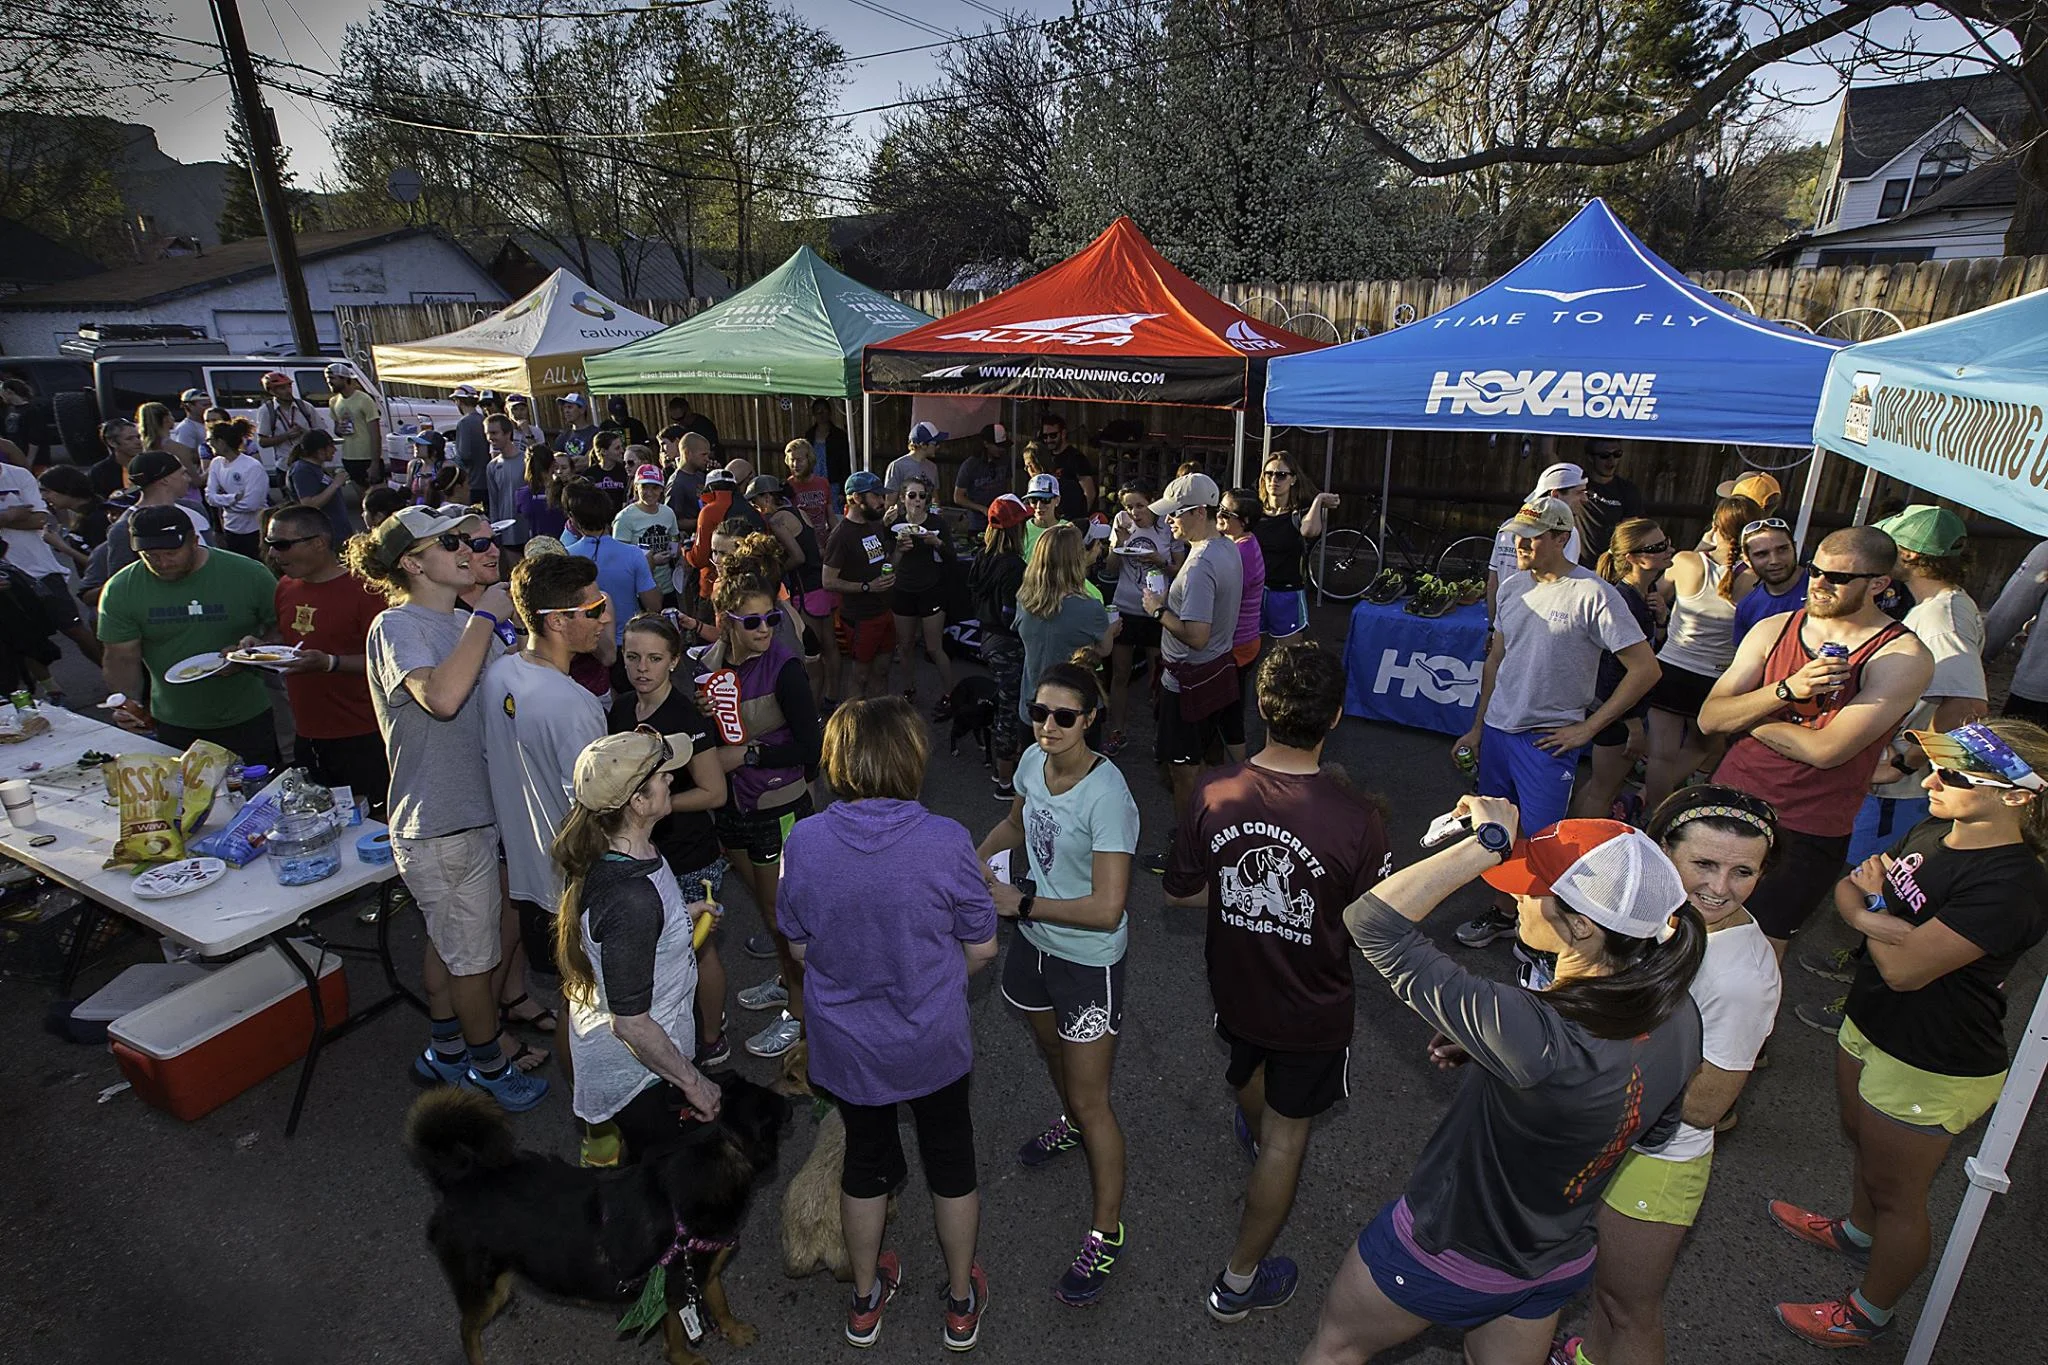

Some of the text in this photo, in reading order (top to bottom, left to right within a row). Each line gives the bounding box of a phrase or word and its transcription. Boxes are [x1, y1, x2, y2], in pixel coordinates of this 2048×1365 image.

[1433, 311, 1709, 328] TIME TO FLY
[936, 329, 1135, 347] ALTRA
[1229, 338, 1286, 350] ALTRA
[543, 366, 567, 384] All
[978, 366, 1166, 385] WWW.ALTRARUNNING.COM
[1425, 370, 1657, 417] HOKA ONE
[1872, 385, 1947, 454] DURANGO
[1936, 394, 2043, 481] RUNNING
[863, 538, 882, 551] RUN
[1210, 824, 1241, 854] S&M
[1241, 821, 1327, 879] CONCRETE
[1221, 909, 1313, 946] 516-546-4976
